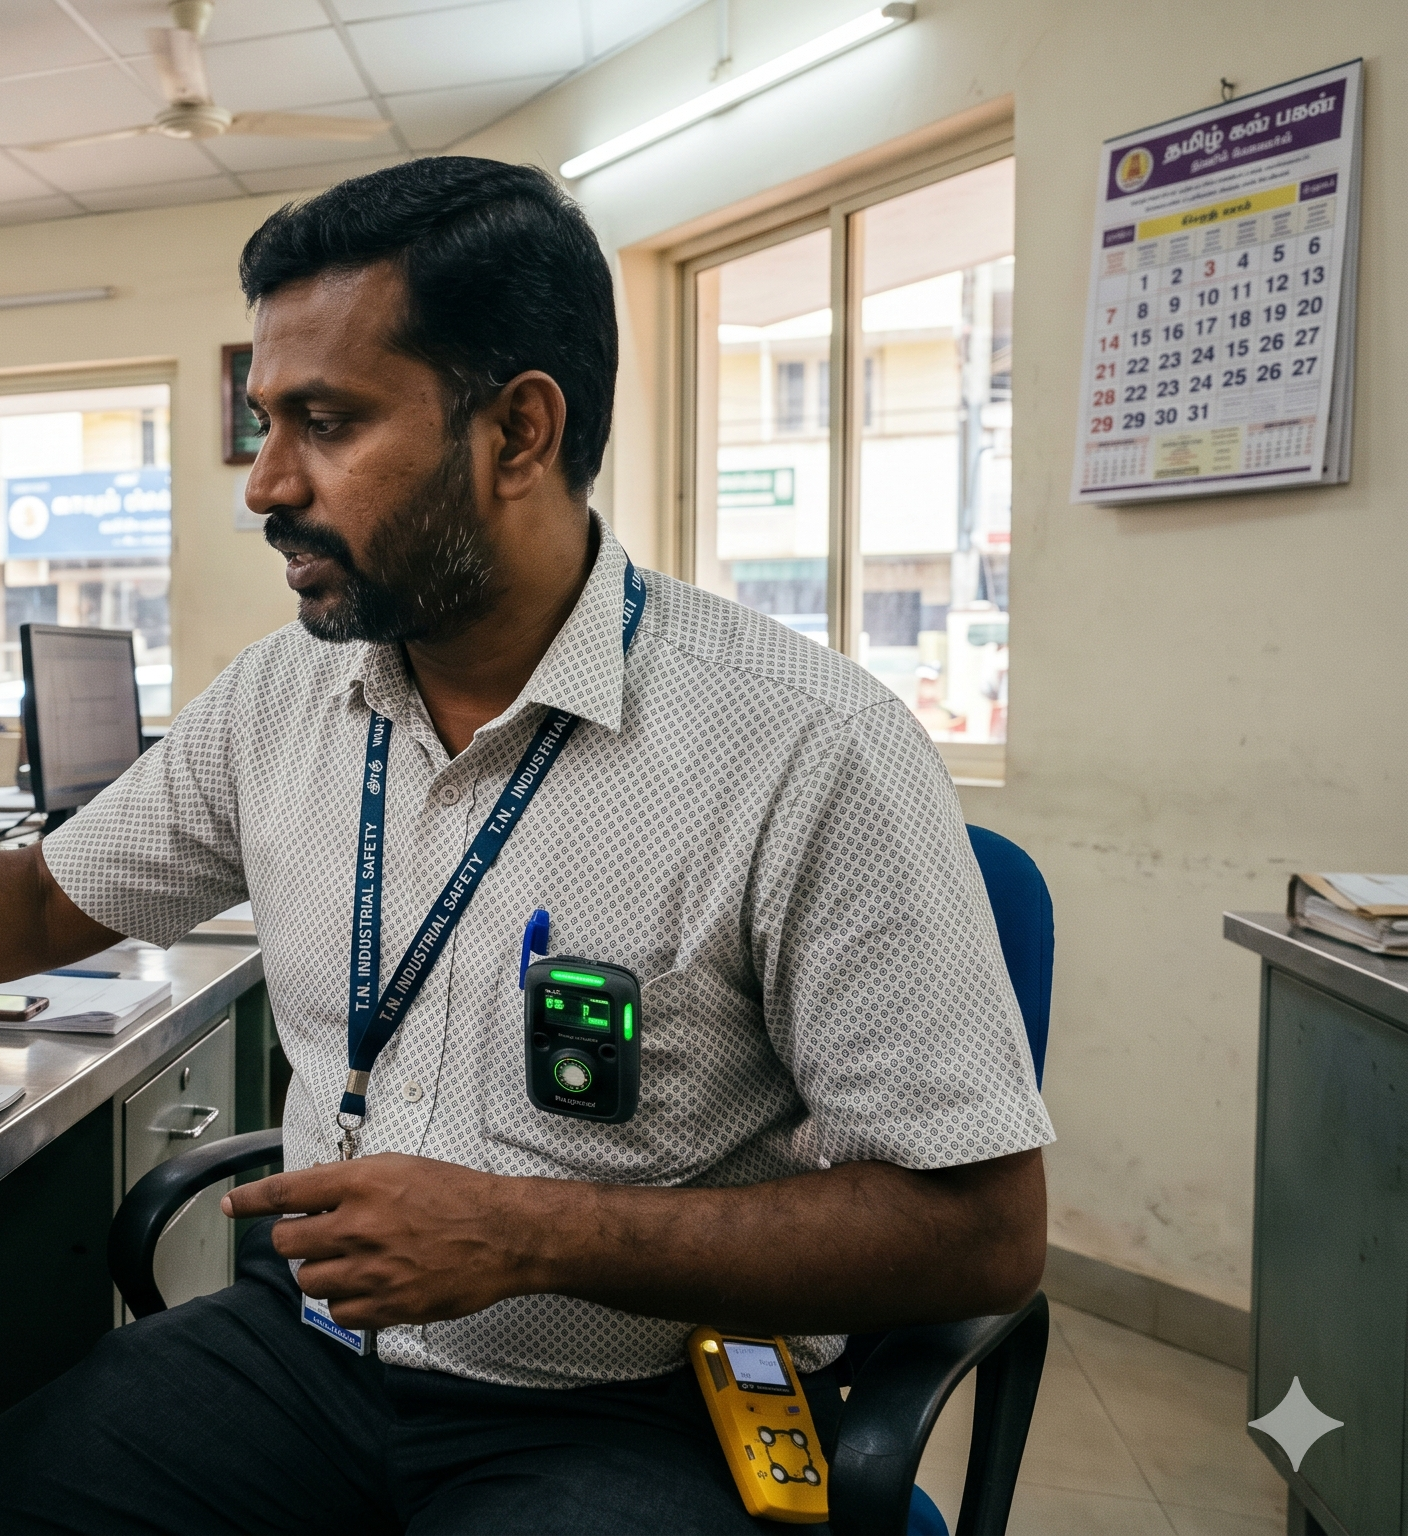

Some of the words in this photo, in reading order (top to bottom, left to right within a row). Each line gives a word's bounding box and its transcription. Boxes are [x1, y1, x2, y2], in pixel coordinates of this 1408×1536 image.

[1162, 123, 1224, 165] தமிழ்
[1141, 275, 1147, 290] 1
[1172, 268, 1182, 285] 2
[1205, 260, 1215, 278] 3
[1238, 253, 1248, 268] 4
[1273, 245, 1284, 262] 5
[1309, 237, 1320, 254] 6
[1107, 307, 1117, 324] 7
[1138, 303, 1148, 319] 8
[1169, 297, 1180, 313] 9
[1198, 288, 1219, 306] 10
[1232, 282, 1251, 300] 11
[1267, 274, 1288, 293] 12
[1302, 266, 1324, 285] 13
[1101, 335, 1119, 351] 14
[1132, 328, 1151, 346] 15
[1164, 324, 1184, 341] 16
[1197, 316, 1217, 335] 17
[1230, 310, 1251, 328] 18
[1264, 304, 1286, 322] 19
[1298, 296, 1323, 316] 20
[1096, 363, 1115, 380] 21
[1127, 357, 1149, 375] 22
[1159, 352, 1181, 370] 23
[1192, 346, 1214, 364] 24
[1228, 339, 1249, 357] 15
[1260, 333, 1284, 352] 26
[1295, 326, 1320, 347] 27
[1094, 389, 1115, 406] 28
[1125, 385, 1147, 403] 22
[1157, 380, 1179, 397] 23
[1190, 375, 1212, 393] 24
[1223, 368, 1246, 387] 25
[1257, 362, 1281, 382] 26
[1292, 356, 1317, 376] 27
[1091, 416, 1113, 433] 29
[1123, 412, 1145, 429] 29
[1155, 408, 1177, 425] 30
[1188, 404, 1208, 421] 31
[487, 806, 516, 834] T.N.
[363, 822, 378, 880] SAFETY
[358, 884, 374, 977] INDUSTRIAL
[379, 997, 404, 1022] T.N.
[395, 914, 450, 996] INDUSTRIAL
[443, 852, 484, 912] SAFETY
[356, 982, 371, 1012] T.N.
